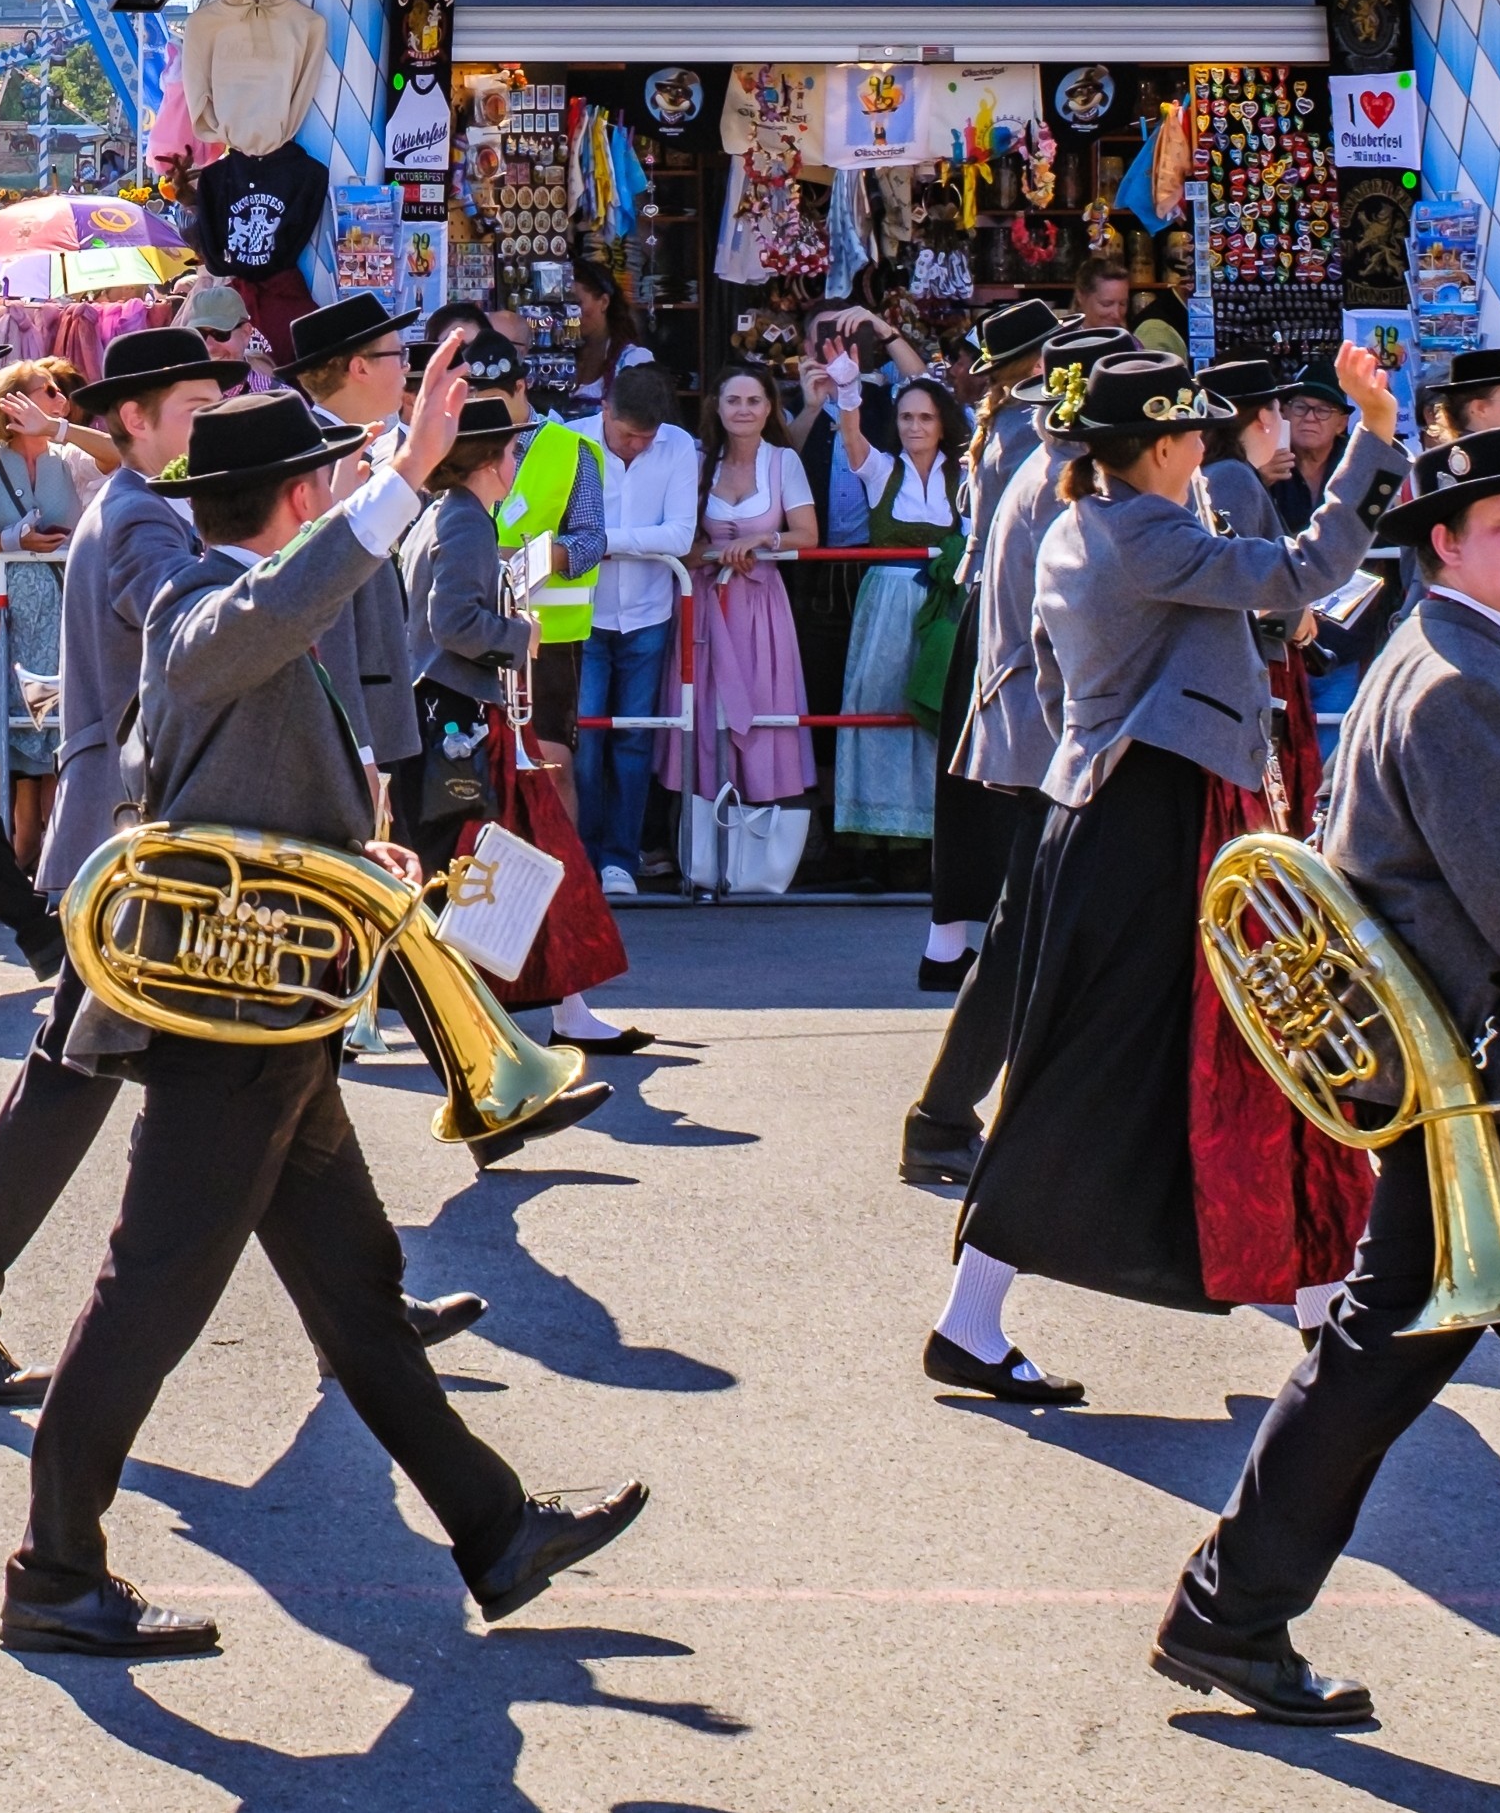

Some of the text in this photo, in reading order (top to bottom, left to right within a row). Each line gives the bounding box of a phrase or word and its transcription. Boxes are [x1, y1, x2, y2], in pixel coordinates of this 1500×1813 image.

[392, 122, 448, 156] Oktoberfest
[1341, 131, 1403, 150] Oktoberfest
[394, 171, 445, 182] OKTOBERFEST
[403, 202, 446, 215] ÜNCHEN
